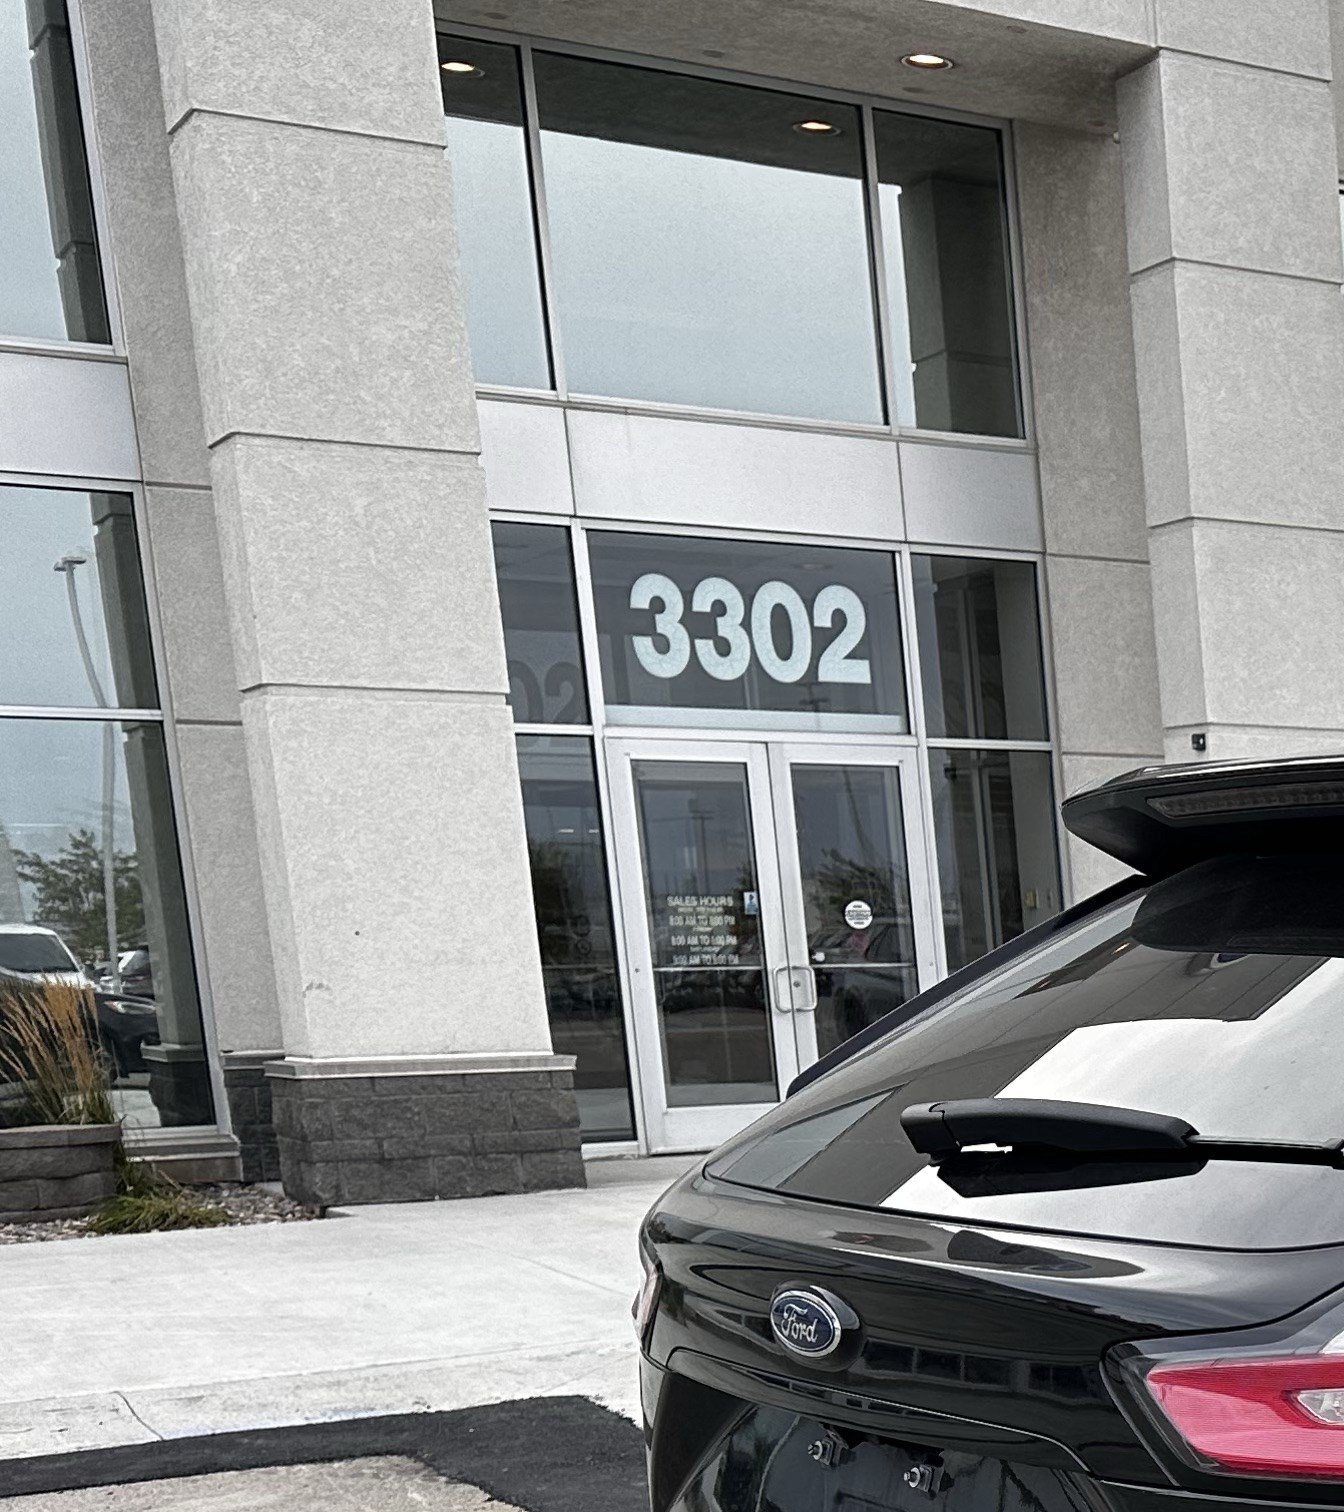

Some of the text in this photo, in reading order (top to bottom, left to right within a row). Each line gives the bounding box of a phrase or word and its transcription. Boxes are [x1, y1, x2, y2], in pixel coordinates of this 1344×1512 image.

[630, 573, 872, 684] 3302
[667, 896, 734, 907] SALES HOURS
[697, 915, 709, 926] TO
[699, 935, 711, 946] TO
[781, 1303, 819, 1343] Ford
